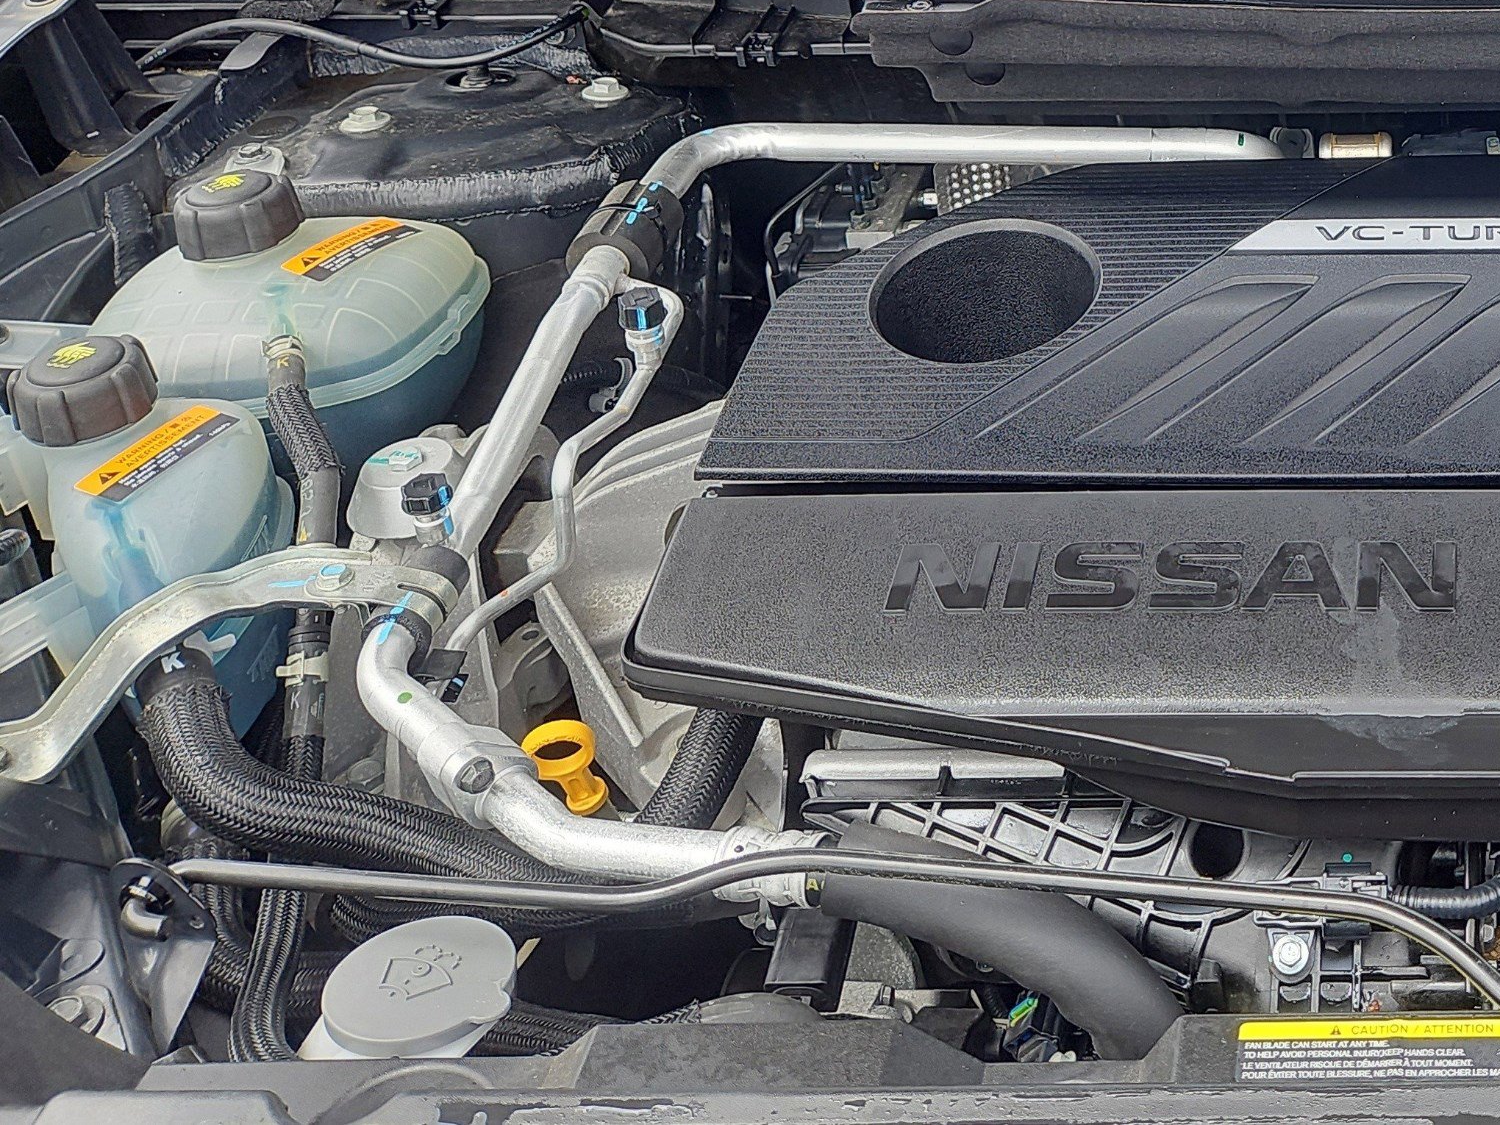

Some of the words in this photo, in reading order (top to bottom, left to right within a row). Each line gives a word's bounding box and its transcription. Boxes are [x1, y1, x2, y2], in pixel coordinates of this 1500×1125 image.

[115, 432, 165, 464] WARNING
[126, 415, 207, 468] AVERTISSEMENT
[884, 541, 1457, 613] NISSAN
[161, 651, 185, 674] K
[290, 690, 301, 710] K
[1351, 1024, 1408, 1035] CAUTION
[1424, 1024, 1494, 1034] ATTENTION
[1244, 1041, 1261, 1050] FAN
[1262, 1041, 1291, 1049] BLADE
[1291, 1041, 1309, 1049] CAN
[1309, 1040, 1337, 1049] START
[1338, 1040, 1349, 1048] AT
[1349, 1040, 1367, 1048] ANY
[1243, 1051, 1257, 1059] TO
[1257, 1051, 1279, 1059] HELP
[1280, 1051, 1306, 1059] AVOID
[1307, 1049, 1353, 1058] PERSONAL
[1435, 1048, 1466, 1056] CLEAR.
[1242, 1062, 1254, 1070] LE
[1254, 1061, 1309, 1069] VENTILATEUR
[1310, 1060, 1341, 1069] RISQUE
[1343, 1060, 1355, 1068] DE
[1356, 1058, 1403, 1068] DÉMARRER
[1411, 1059, 1433, 1067] TOUT
[1434, 1059, 1474, 1067] MOMENT.
[1241, 1071, 1267, 1080] POUR
[1268, 1069, 1297, 1079] ÉVITER
[1297, 1071, 1325, 1079] TOUTE
[1326, 1069, 1373, 1079] BLESSURE,
[1373, 1069, 1387, 1077] NE
[1387, 1068, 1404, 1077] PAS
[1405, 1069, 1418, 1077] EN
[1418, 1068, 1471, 1077] APPROCHER
